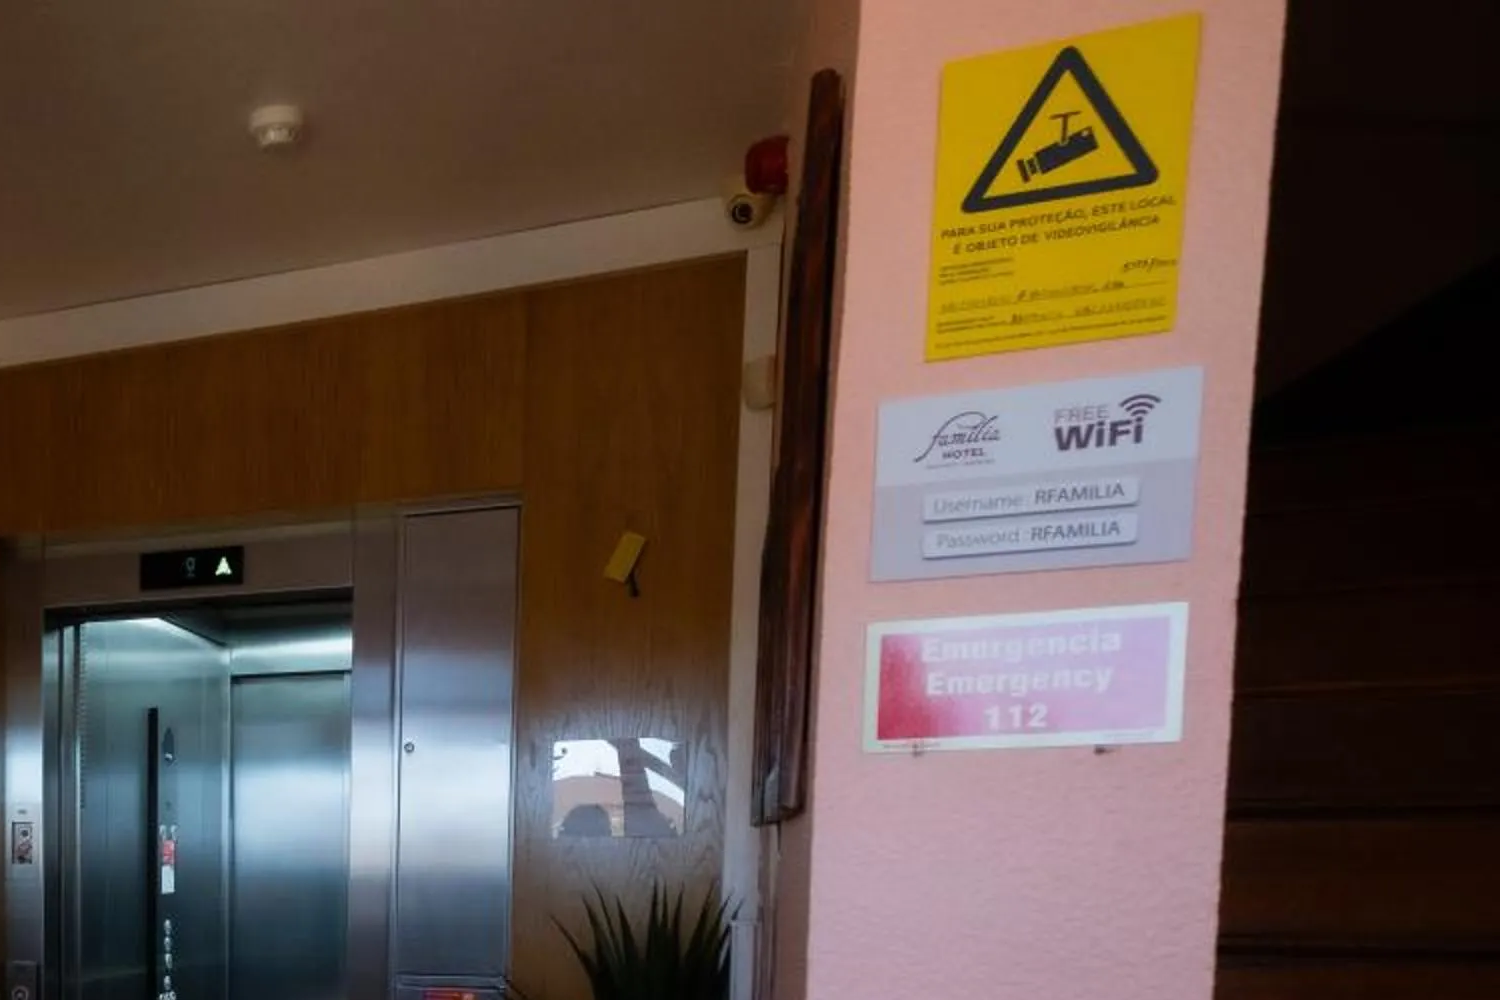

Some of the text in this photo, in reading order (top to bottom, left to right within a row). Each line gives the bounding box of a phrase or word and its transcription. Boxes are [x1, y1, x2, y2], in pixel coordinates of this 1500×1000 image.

[940, 226, 975, 240] PARA
[980, 221, 1006, 234] SUA
[1092, 202, 1124, 217] ESTE
[1129, 195, 1177, 211] LOCAL
[965, 234, 1018, 253] OBJETO
[1021, 232, 1039, 246] DE
[1054, 404, 1111, 424] FREE
[1054, 416, 1144, 452] WiFi
[942, 447, 985, 460] HOTEL
[1035, 482, 1125, 504] RFAMILIA
[1030, 520, 1121, 542] RFAMILIA
[925, 665, 1115, 697] Emergency
[984, 702, 1048, 730] 112
